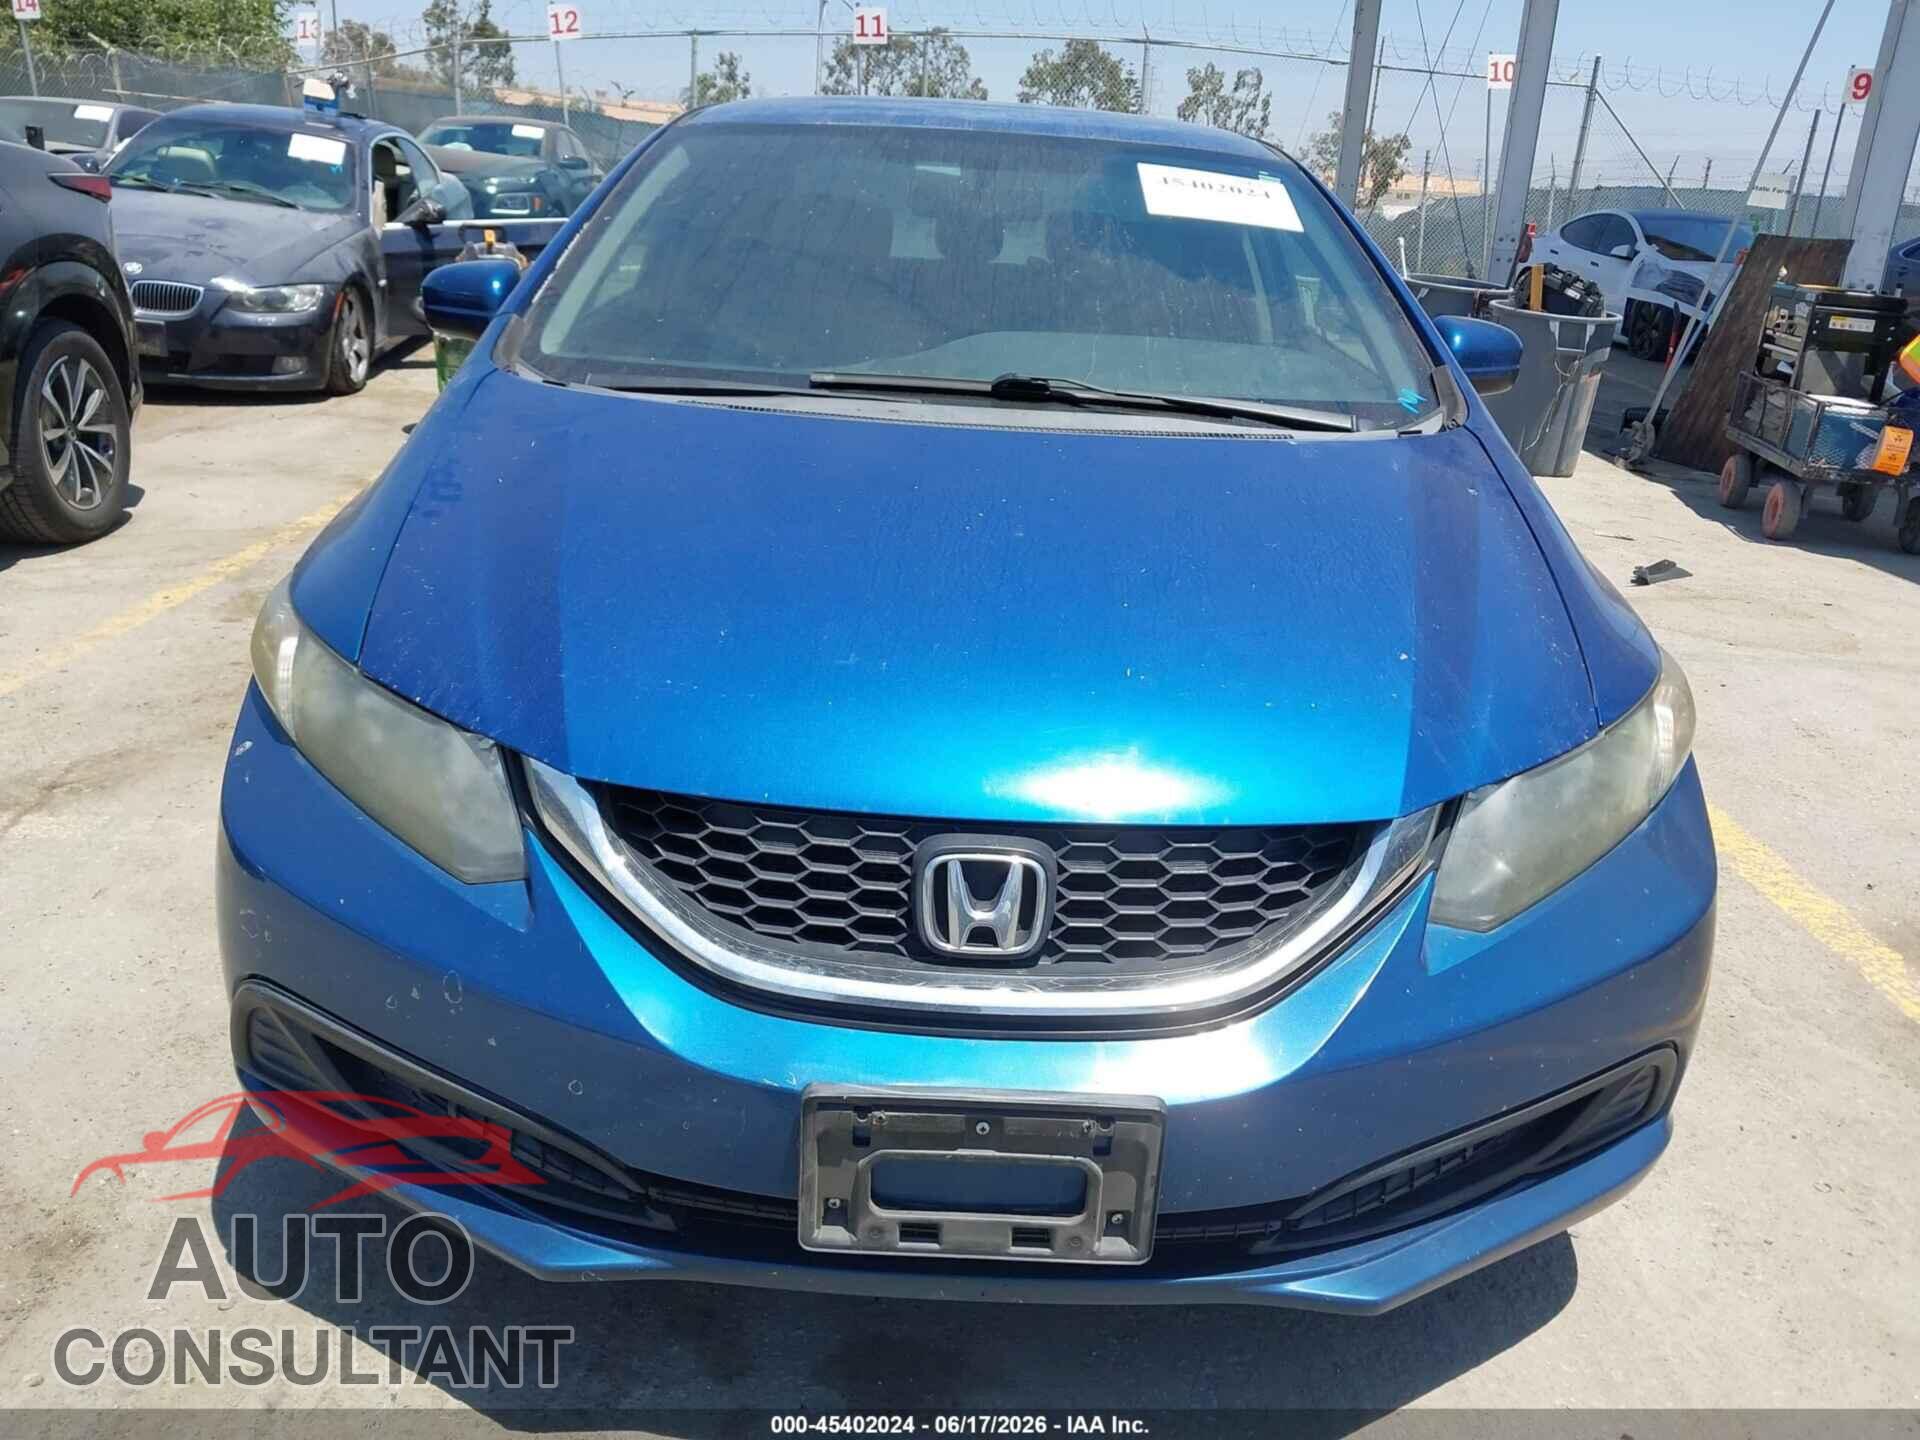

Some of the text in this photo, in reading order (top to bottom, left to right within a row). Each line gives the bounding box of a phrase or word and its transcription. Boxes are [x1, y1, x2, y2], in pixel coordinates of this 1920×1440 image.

[550, 10, 579, 34] 12
[856, 15, 885, 37] 11
[1489, 61, 1515, 82] 10
[1852, 73, 1872, 100] 9
